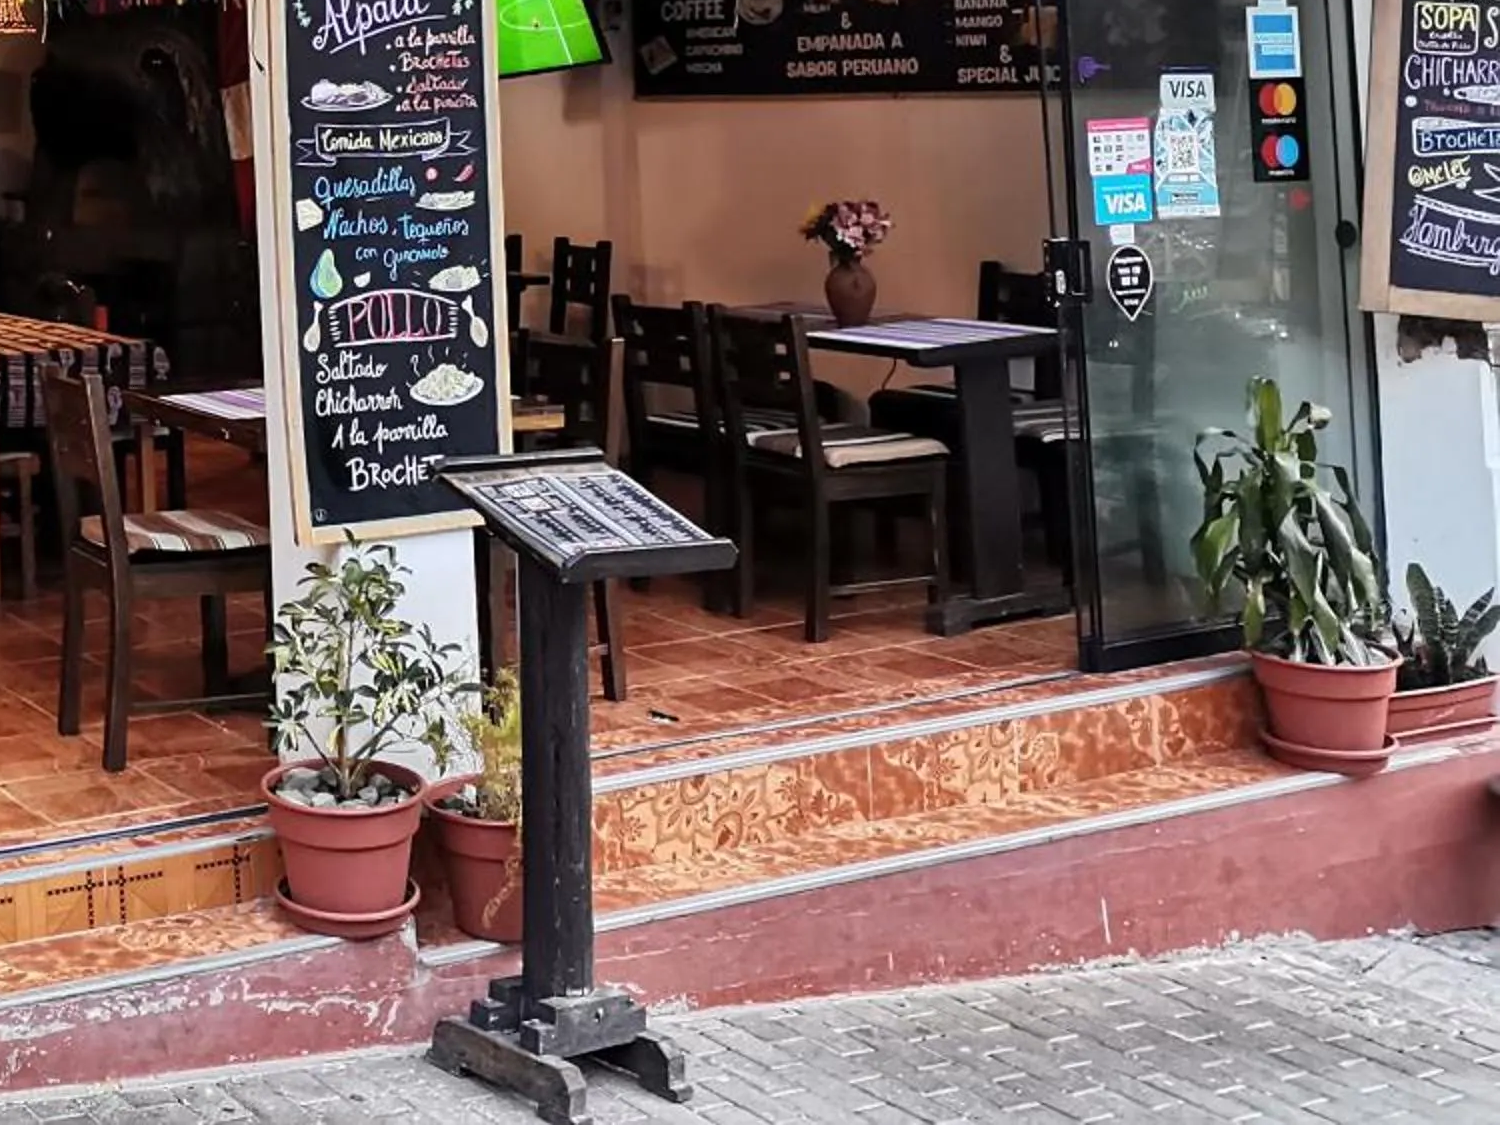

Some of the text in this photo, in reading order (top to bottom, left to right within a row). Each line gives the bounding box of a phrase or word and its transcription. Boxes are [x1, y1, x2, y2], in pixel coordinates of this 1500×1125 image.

[955, 15, 1003, 29] MANGO
[1420, 4, 1476, 31] SOPA
[395, 35, 405, 48] a
[407, 25, 424, 48] la
[797, 31, 904, 53] EMPANADA A
[1000, 44, 1013, 64] &
[786, 57, 919, 78] SABOR PERUANO
[957, 66, 1018, 84] SPECIAL
[1168, 80, 1207, 99] VISA
[321, 128, 444, 152] Comida Mexicana
[315, 165, 416, 210] Quesadillas
[1104, 192, 1147, 215] VISA
[355, 246, 378, 261] con
[347, 292, 442, 340] POLLO
[315, 350, 388, 384] Saltado
[350, 422, 368, 445] la
[372, 414, 448, 453] parrilla
